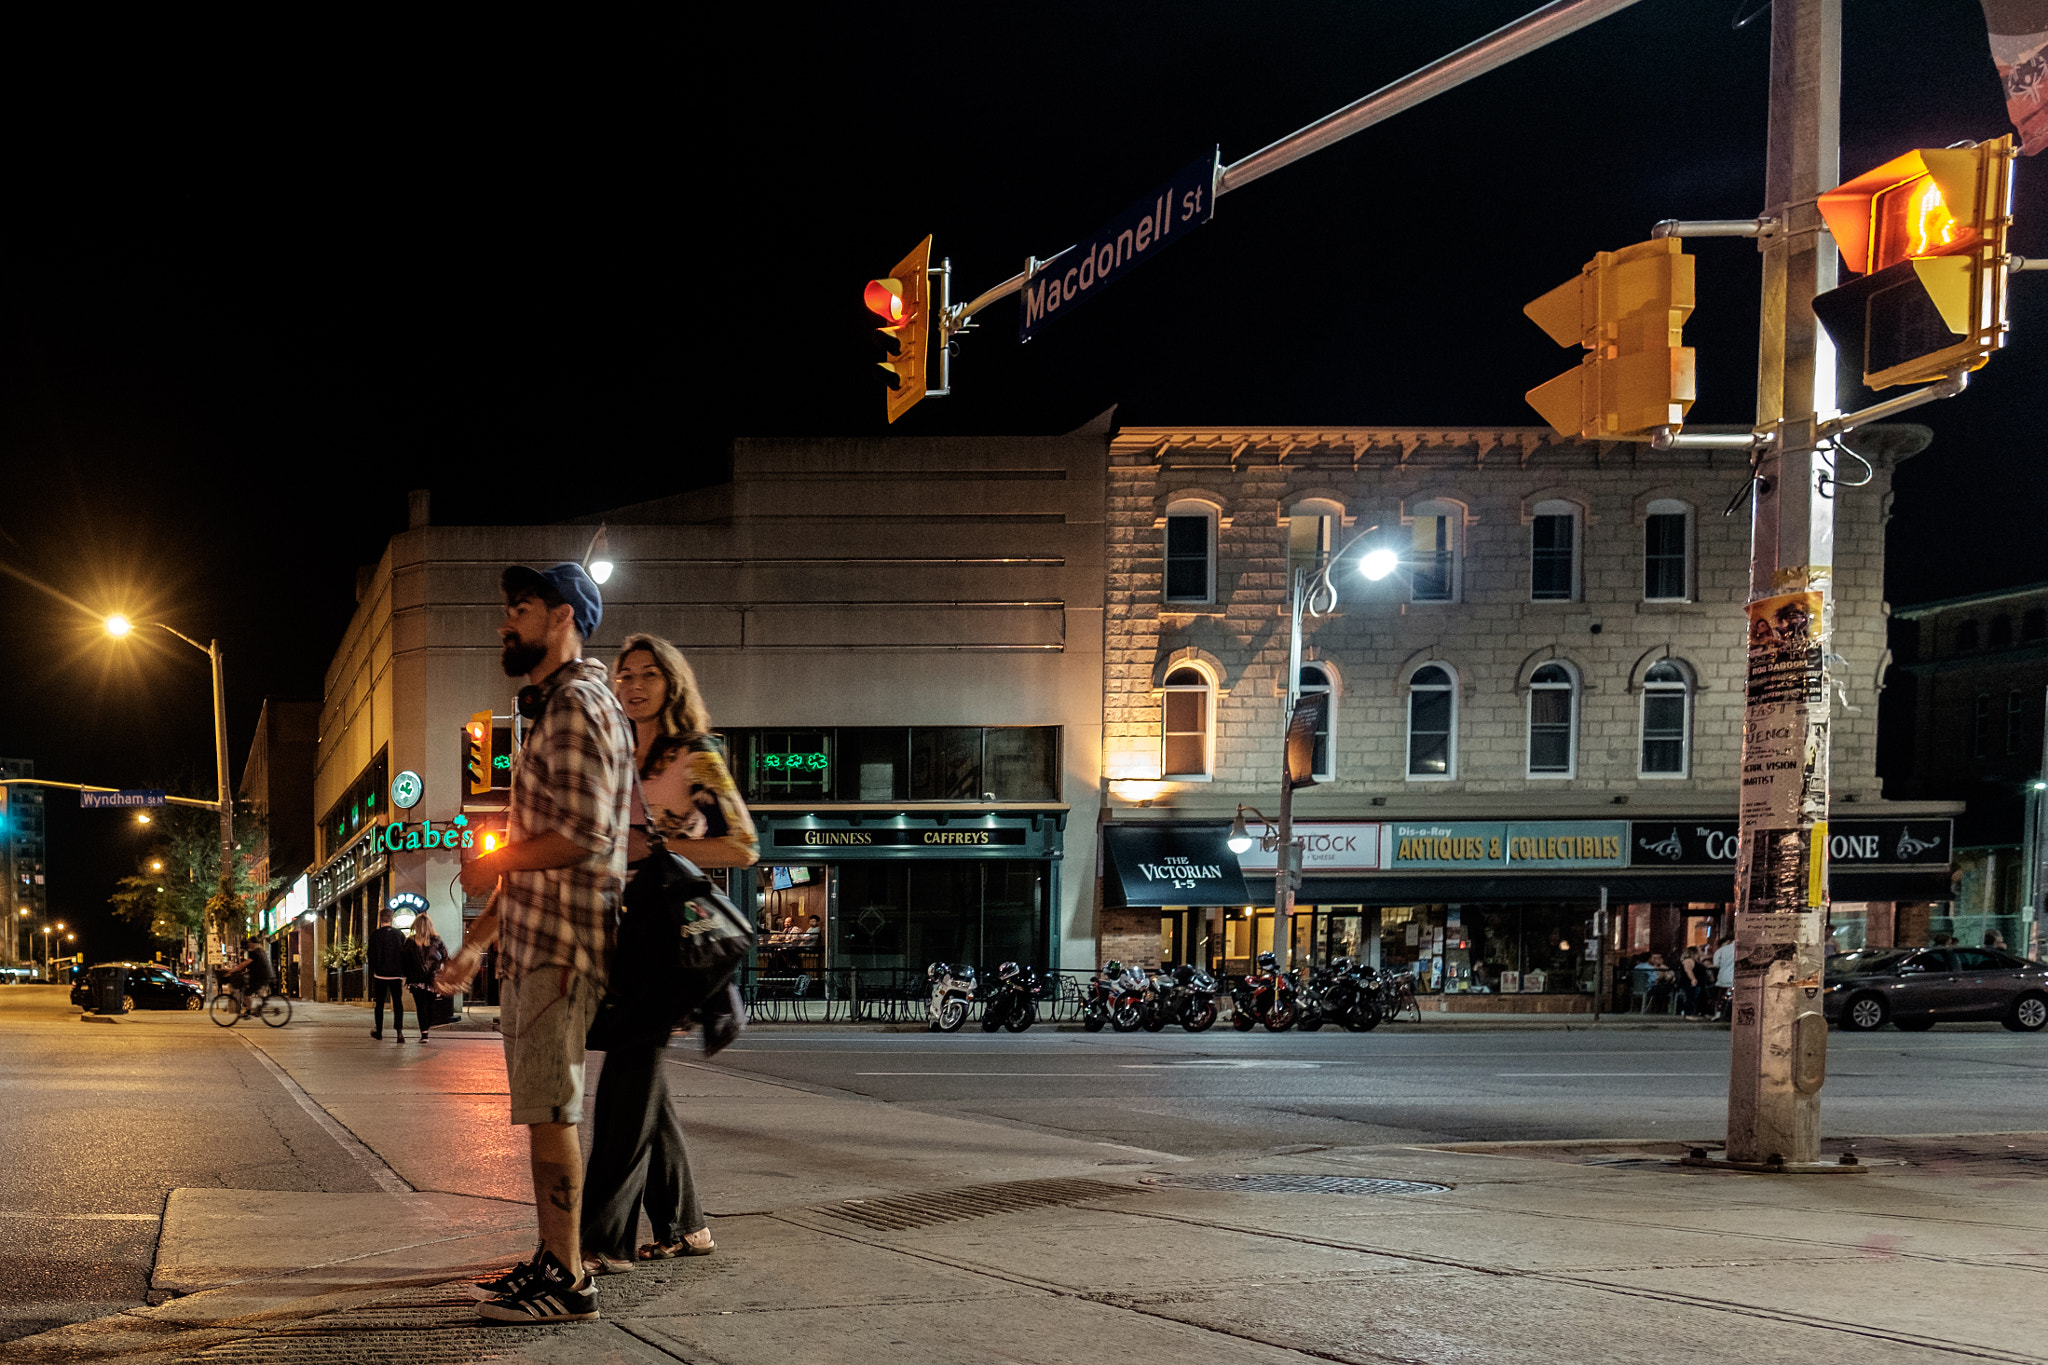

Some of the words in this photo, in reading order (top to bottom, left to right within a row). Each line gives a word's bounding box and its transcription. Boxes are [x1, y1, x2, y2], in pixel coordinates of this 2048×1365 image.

[1026, 187, 1173, 328] Macdonell
[1181, 184, 1203, 222] St
[1766, 760, 1797, 770] VISION
[83, 793, 144, 808] Wyndham
[804, 830, 872, 844] GUINNESS
[923, 831, 989, 844] CAFFREY'S
[1398, 826, 1452, 838] Dis-a-Ray
[1297, 836, 1357, 852] BLOCK
[1397, 836, 1483, 860] ANTIQUES
[1488, 836, 1501, 859] &
[1509, 835, 1621, 860] COLLECTIBLES
[1163, 856, 1190, 865] THE
[1137, 863, 1222, 882] VICTORIAN
[1172, 879, 1196, 889] 1-5
[389, 893, 425, 909] OPEN
